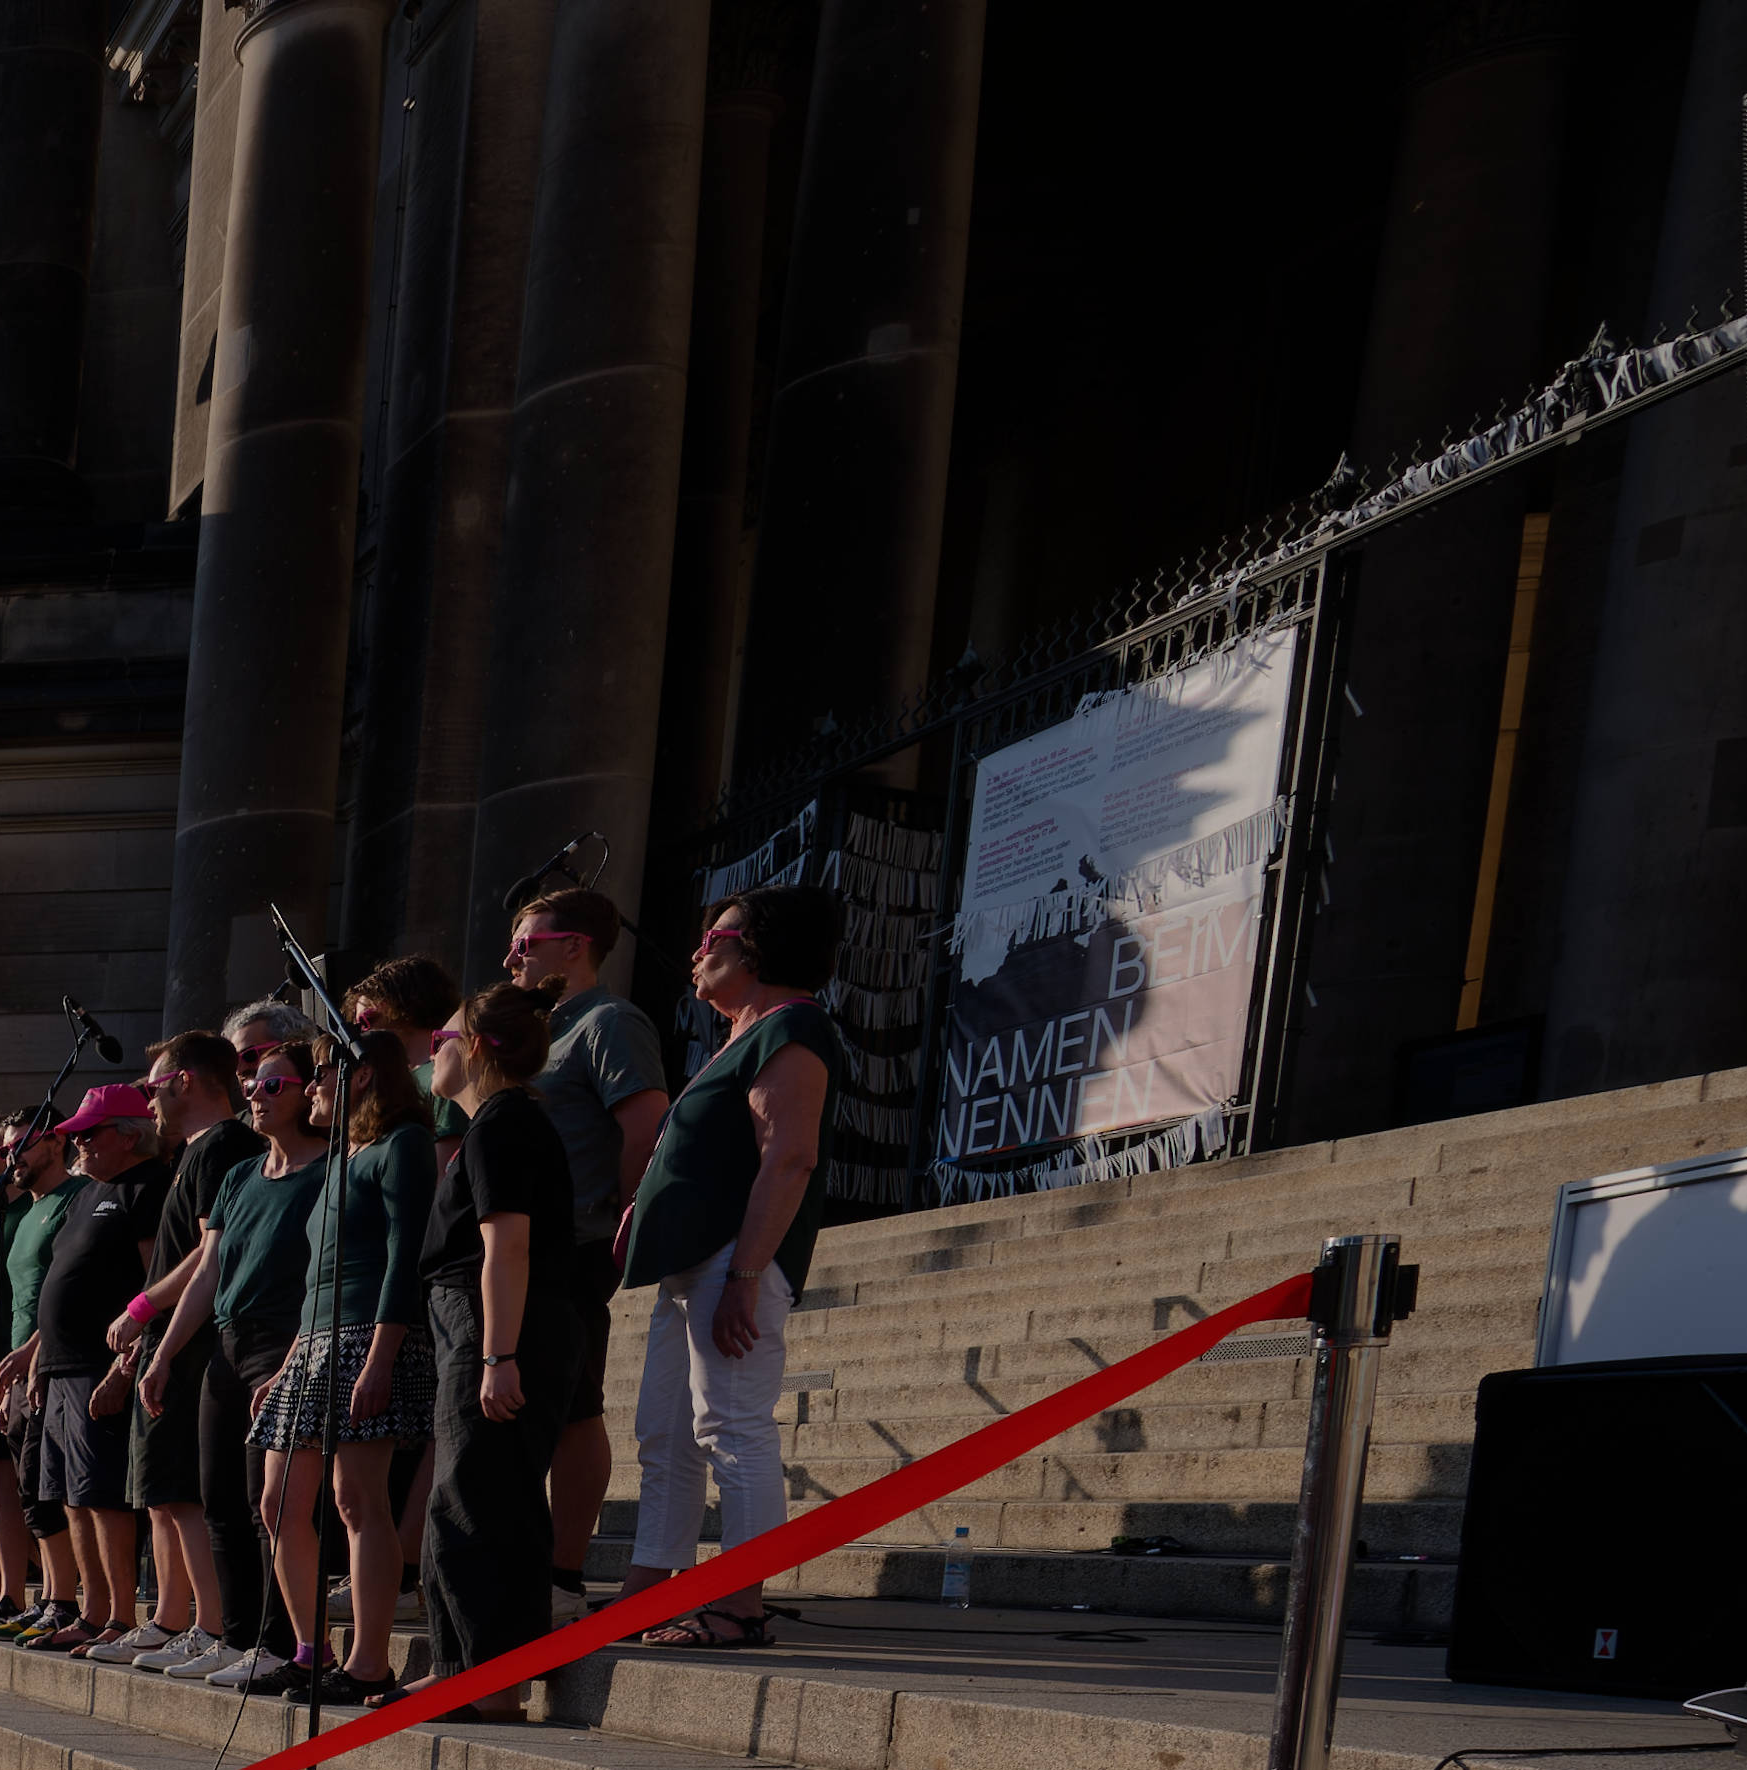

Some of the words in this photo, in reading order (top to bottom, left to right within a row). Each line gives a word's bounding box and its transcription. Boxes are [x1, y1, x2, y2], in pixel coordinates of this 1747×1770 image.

[1108, 903, 1259, 1001] BEIM
[942, 1000, 1133, 1104] NAMEN
[935, 1062, 1157, 1159] NENNEN
